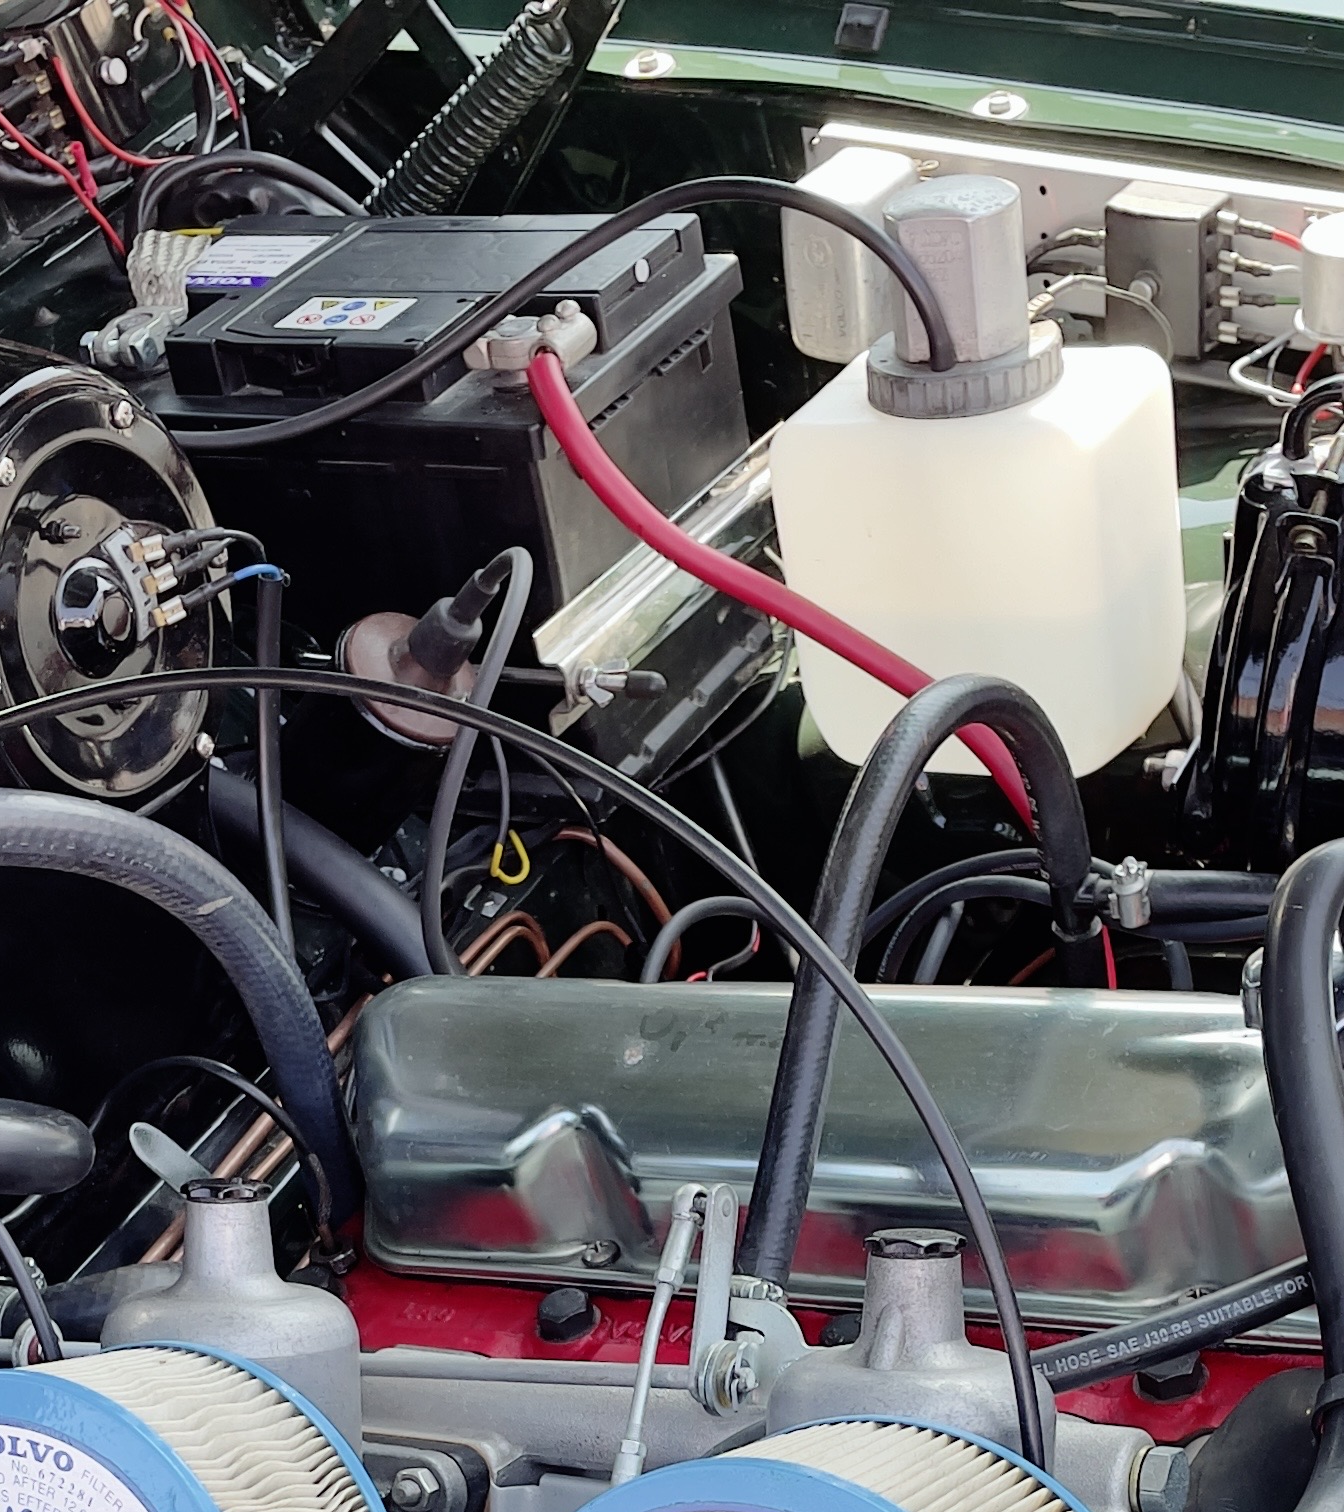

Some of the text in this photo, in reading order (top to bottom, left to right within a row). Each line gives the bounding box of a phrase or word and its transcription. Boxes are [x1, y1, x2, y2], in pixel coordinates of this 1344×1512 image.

[1056, 1349, 1102, 1373] HOSE
[1105, 1337, 1141, 1360] SAE
[1196, 1290, 1273, 1329] SUITABLE
[1274, 1274, 1308, 1300] FOR
[13, 1474, 55, 1499] AFTER
[81, 1469, 124, 1512] FILTER
